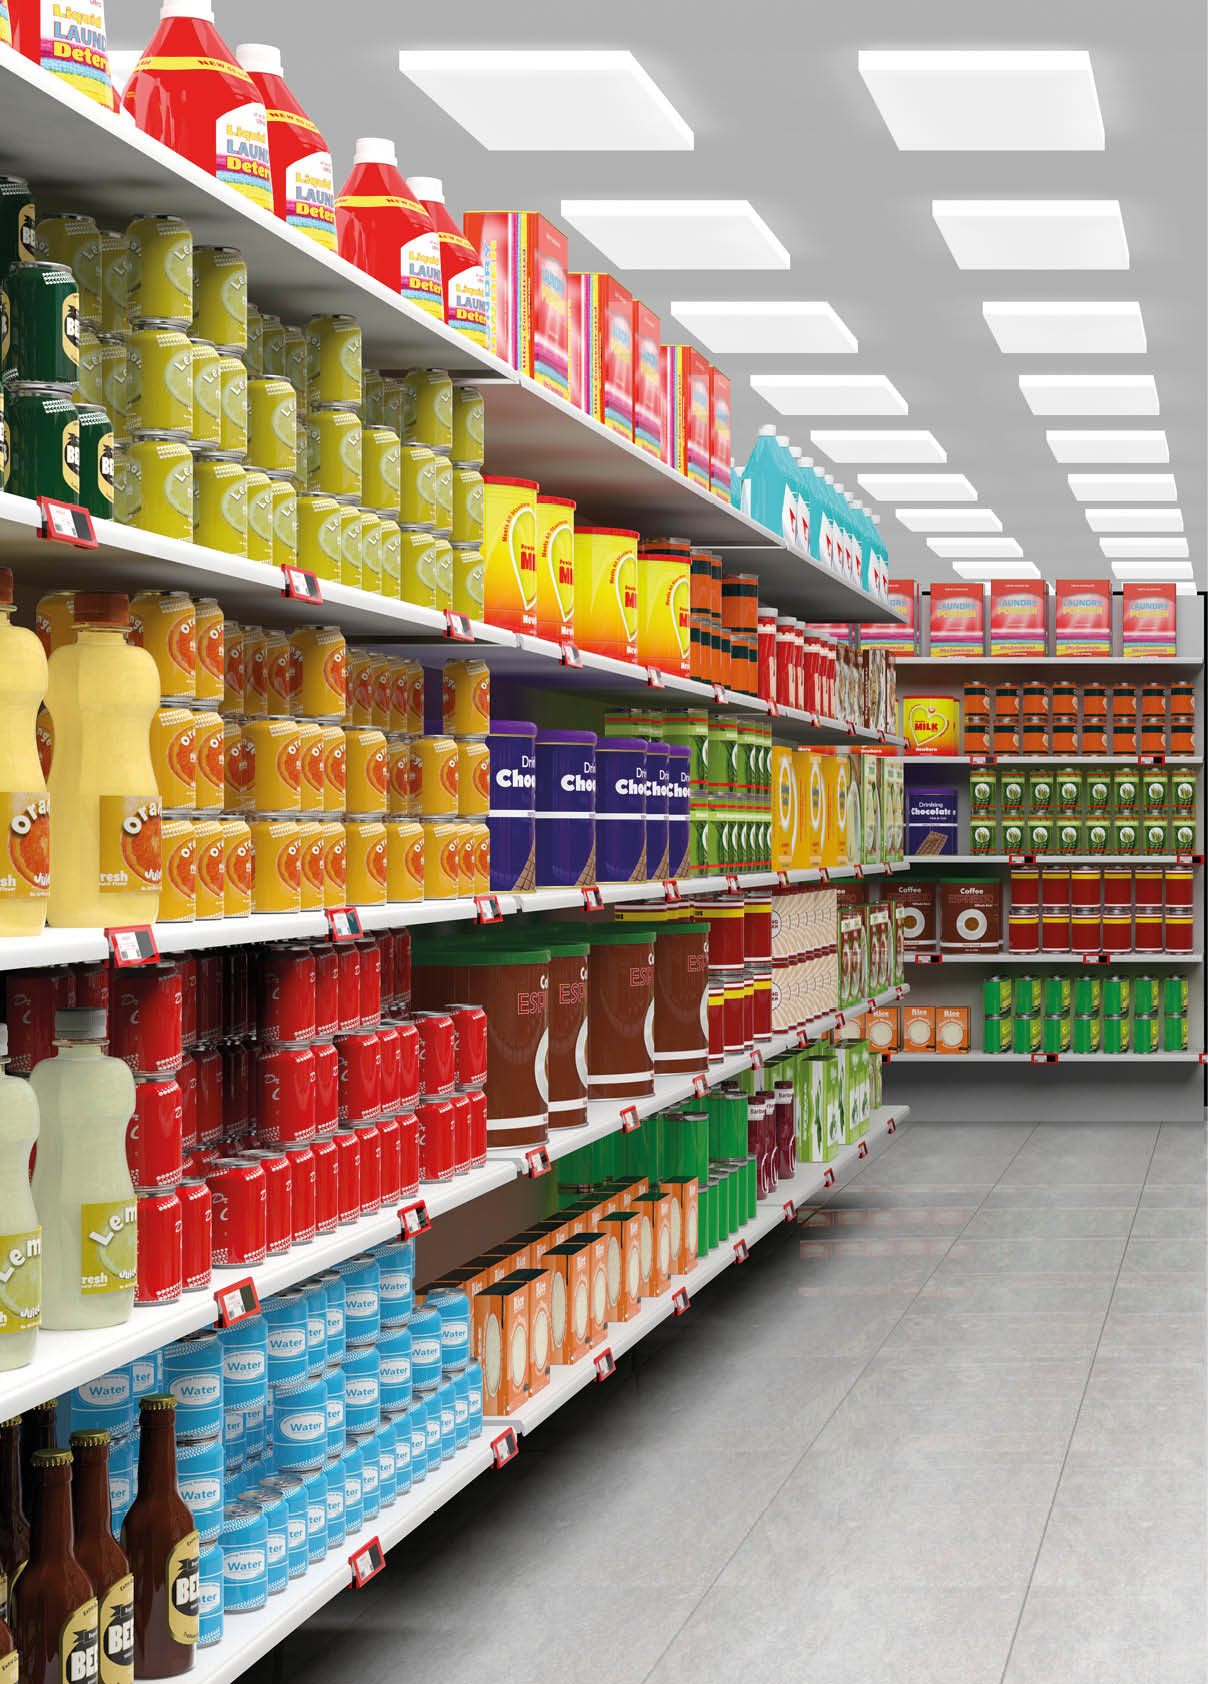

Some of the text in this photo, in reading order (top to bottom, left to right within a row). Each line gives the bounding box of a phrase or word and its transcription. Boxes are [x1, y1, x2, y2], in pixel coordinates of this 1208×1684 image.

[53, 4, 101, 28] Liquid
[914, 723, 938, 731] MILK
[898, 886, 922, 894] Coffee
[911, 1008, 928, 1016] Rice
[346, 1298, 376, 1309] Water
[270, 1337, 303, 1348] Water
[227, 1360, 262, 1372] Water
[380, 1366, 408, 1376] Water
[89, 1385, 126, 1396] Water
[180, 1384, 217, 1396] Water
[346, 1387, 375, 1397] Water
[290, 1421, 322, 1433] Water
[180, 1488, 217, 1500] Water
[227, 1559, 262, 1571] Water
